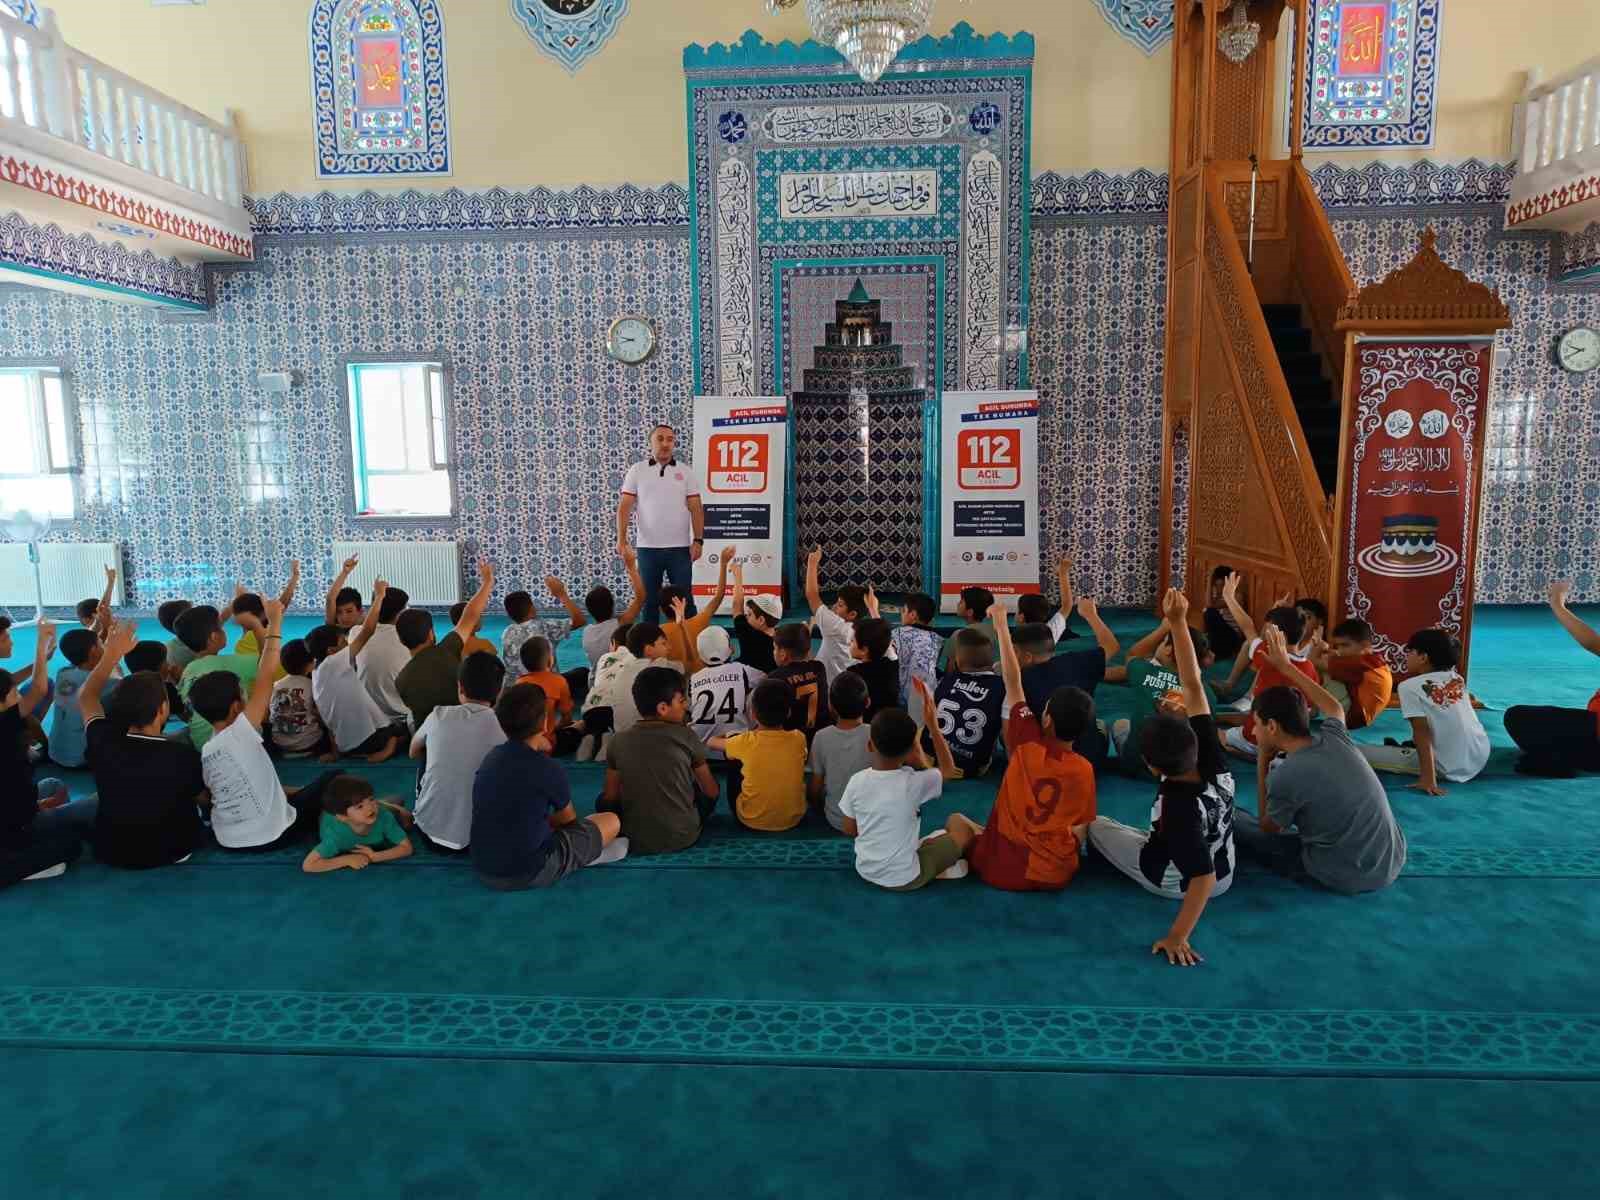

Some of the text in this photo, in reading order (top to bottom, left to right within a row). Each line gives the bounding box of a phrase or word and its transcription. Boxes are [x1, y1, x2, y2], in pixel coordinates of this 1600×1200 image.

[716, 440, 760, 467] 112
[967, 435, 1011, 464] 112
[696, 687, 739, 724] 24
[797, 681, 818, 728] 7
[936, 698, 988, 745] 53
[1025, 778, 1062, 825] 9
